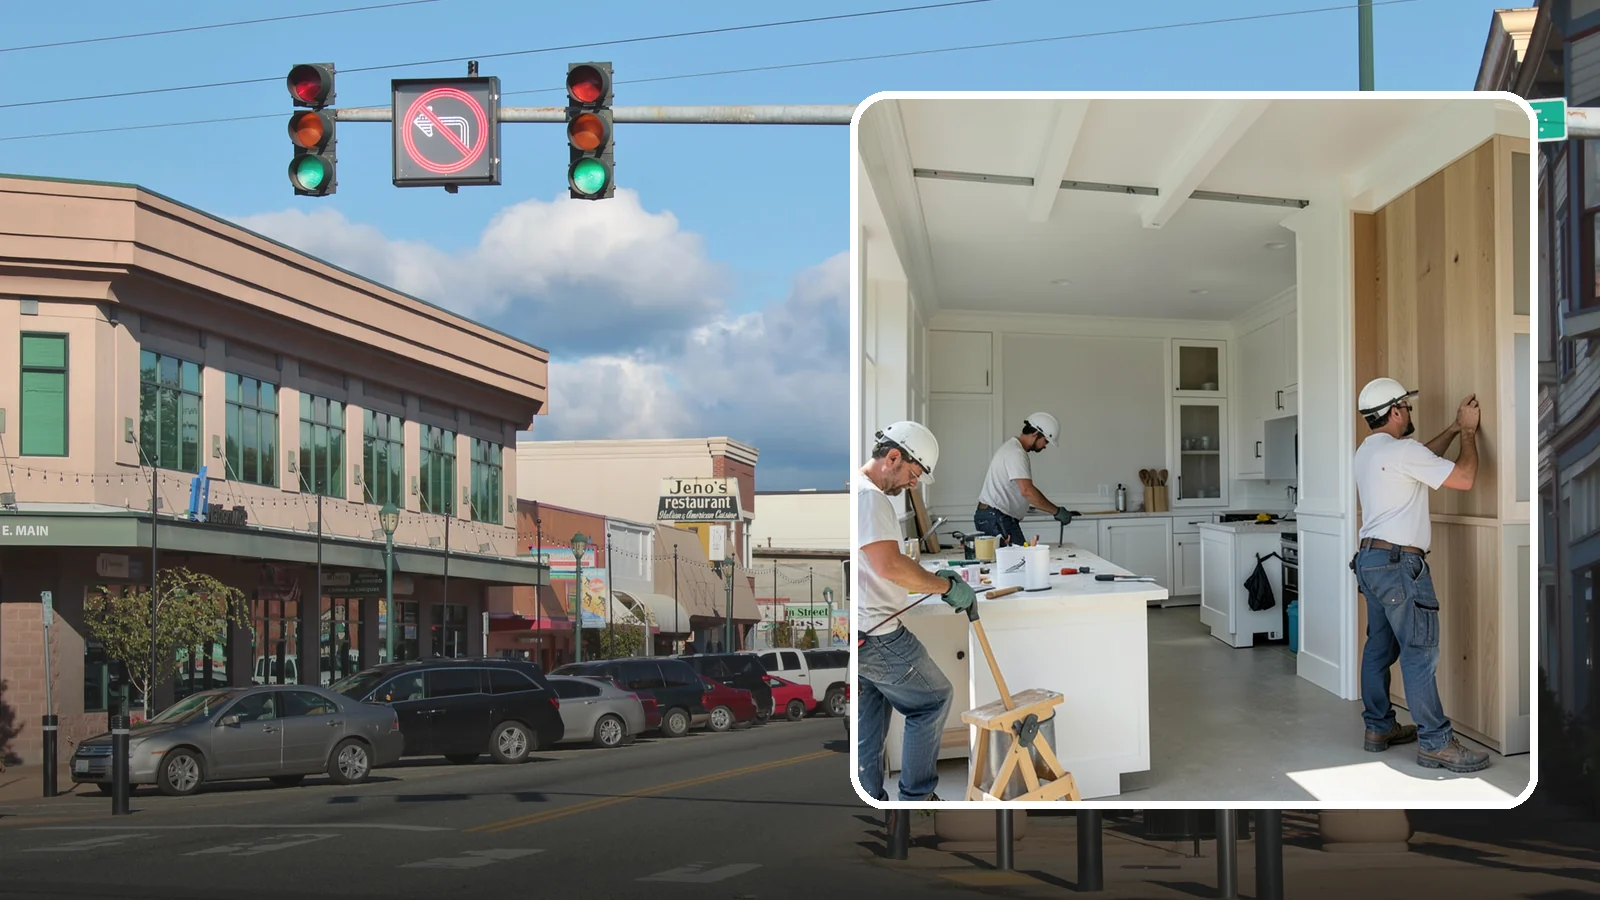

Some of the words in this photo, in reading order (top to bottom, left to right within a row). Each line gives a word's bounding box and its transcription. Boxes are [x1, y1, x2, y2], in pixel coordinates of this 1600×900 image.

[670, 480, 727, 494] Jeno's
[665, 496, 731, 509] restaurant
[659, 510, 681, 519] Italian
[686, 510, 714, 519] American
[715, 510, 738, 519] Cuisine
[2, 525, 13, 536] E.
[15, 525, 49, 536] MAIN
[797, 607, 829, 617] Street
